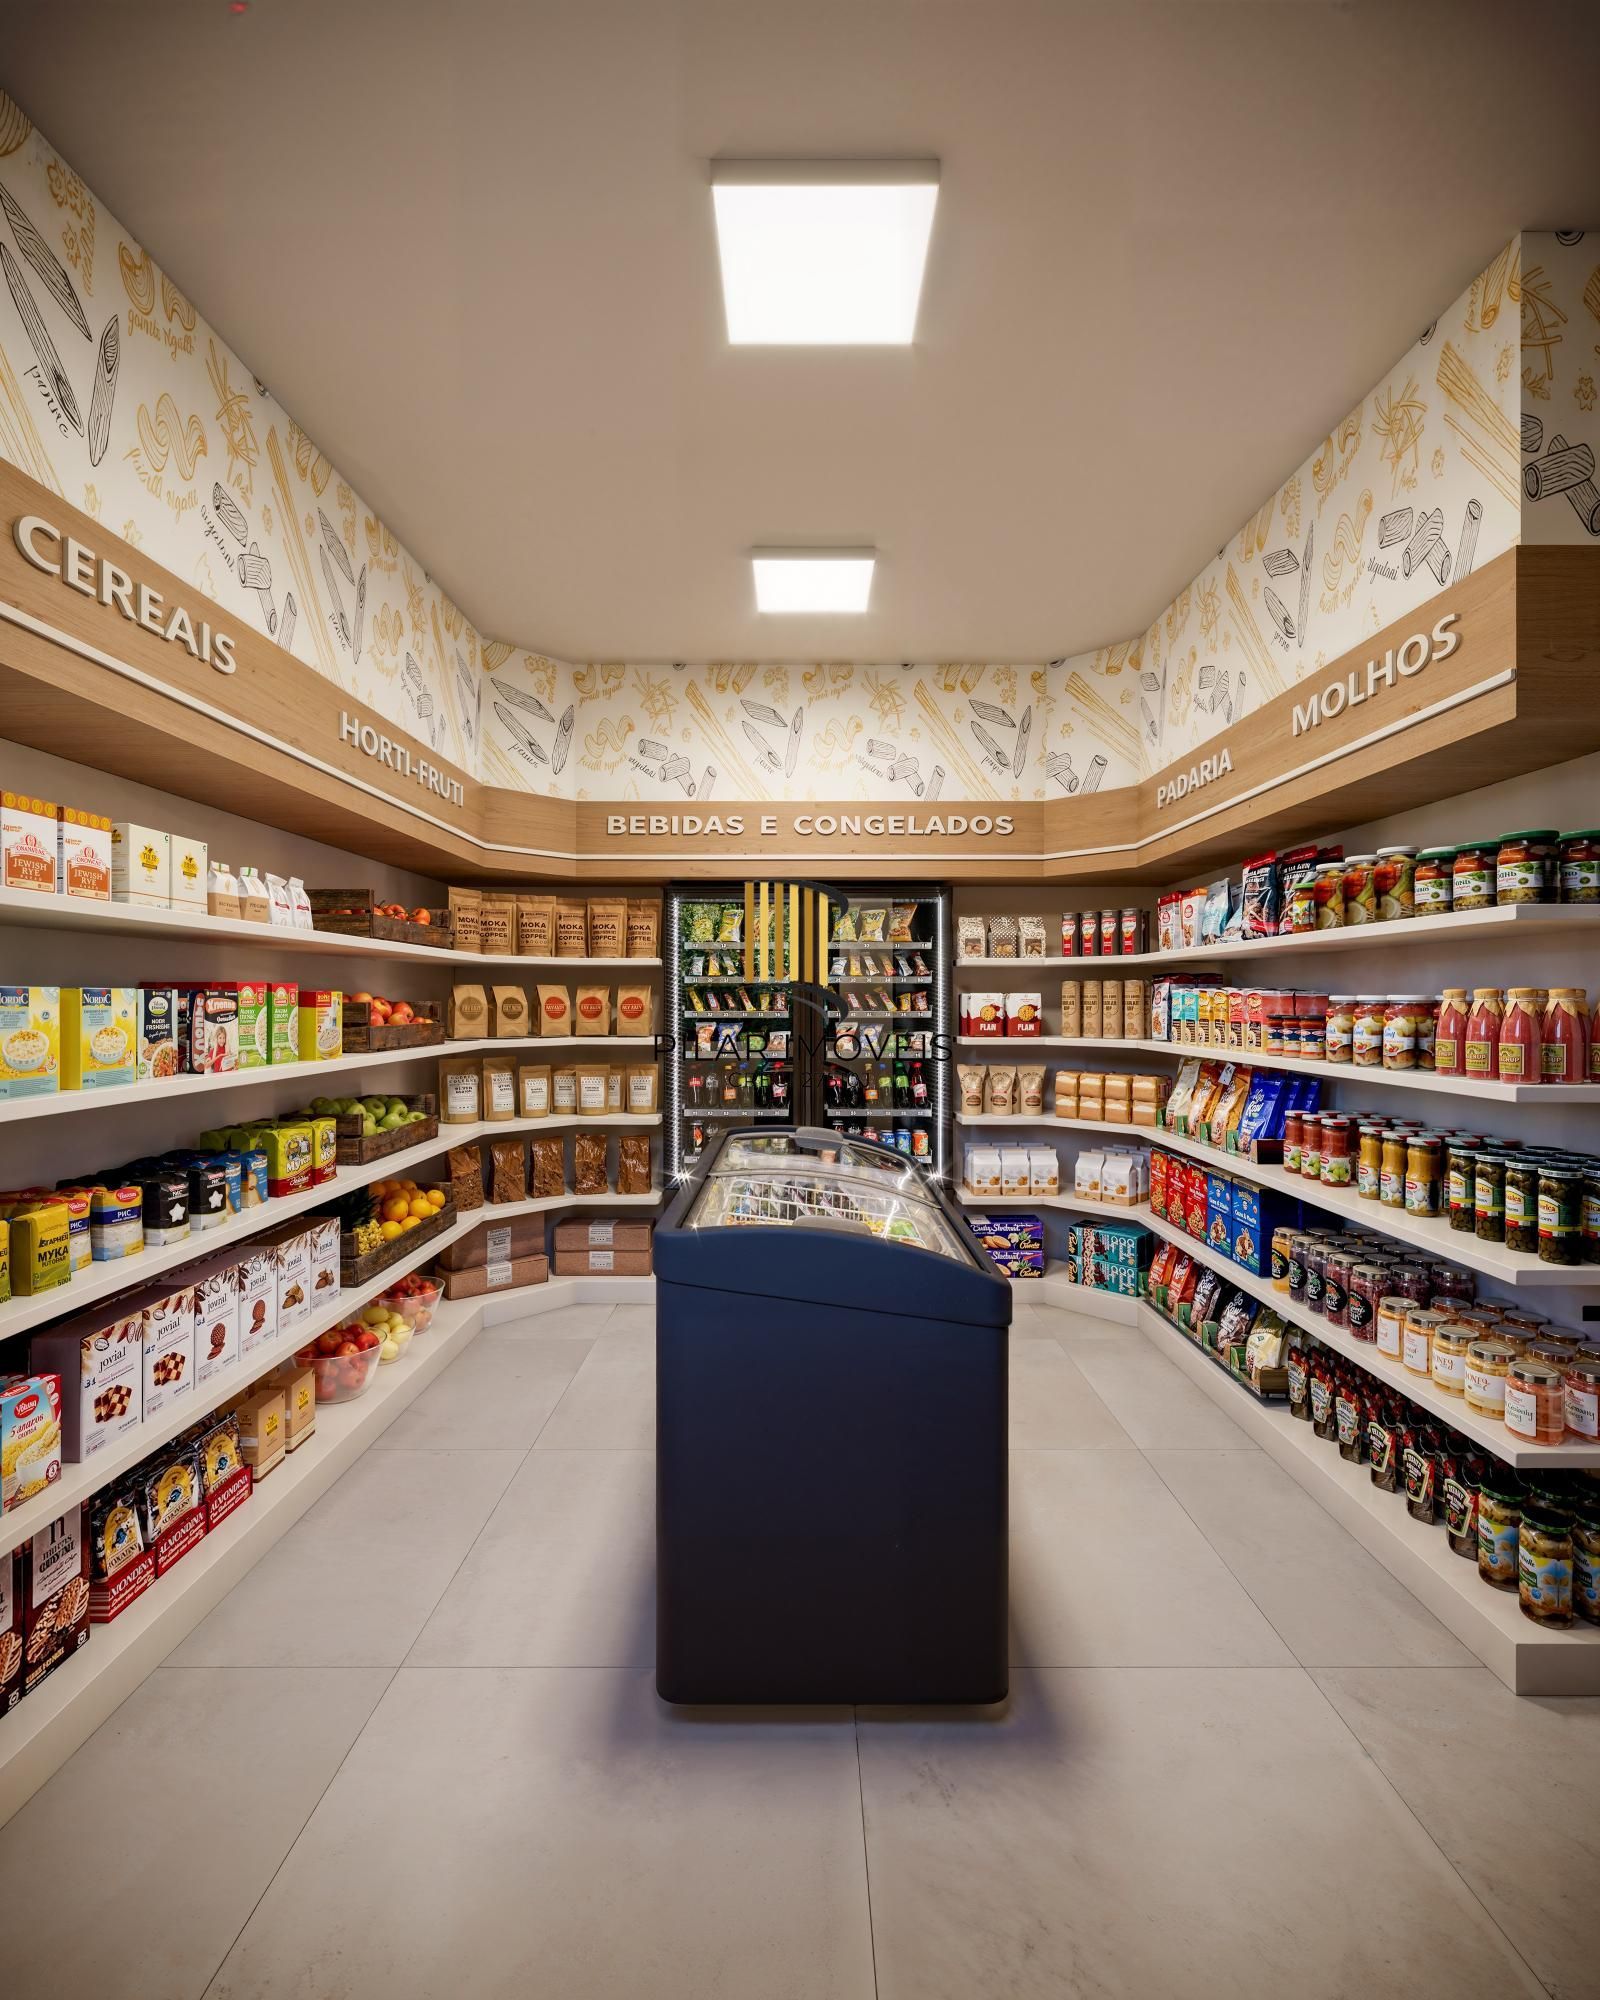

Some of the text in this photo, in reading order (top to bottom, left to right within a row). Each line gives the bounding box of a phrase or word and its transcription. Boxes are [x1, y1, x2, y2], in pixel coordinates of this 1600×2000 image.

[12, 515, 237, 675] CEREAIS
[1292, 613, 1461, 737] MOLHOS
[338, 711, 464, 807] HORTI-FRUTI
[1156, 748, 1235, 810] PADARIA
[607, 815, 1015, 835] BEBIDAS E CONGELADOS
[13, 858, 47, 871] JEWISH
[22, 866, 40, 876] RYE
[74, 868, 103, 880] JEWISH
[81, 876, 97, 886] RYE
[157, 1317, 181, 1340] jovial
[99, 1346, 127, 1373] jovial
